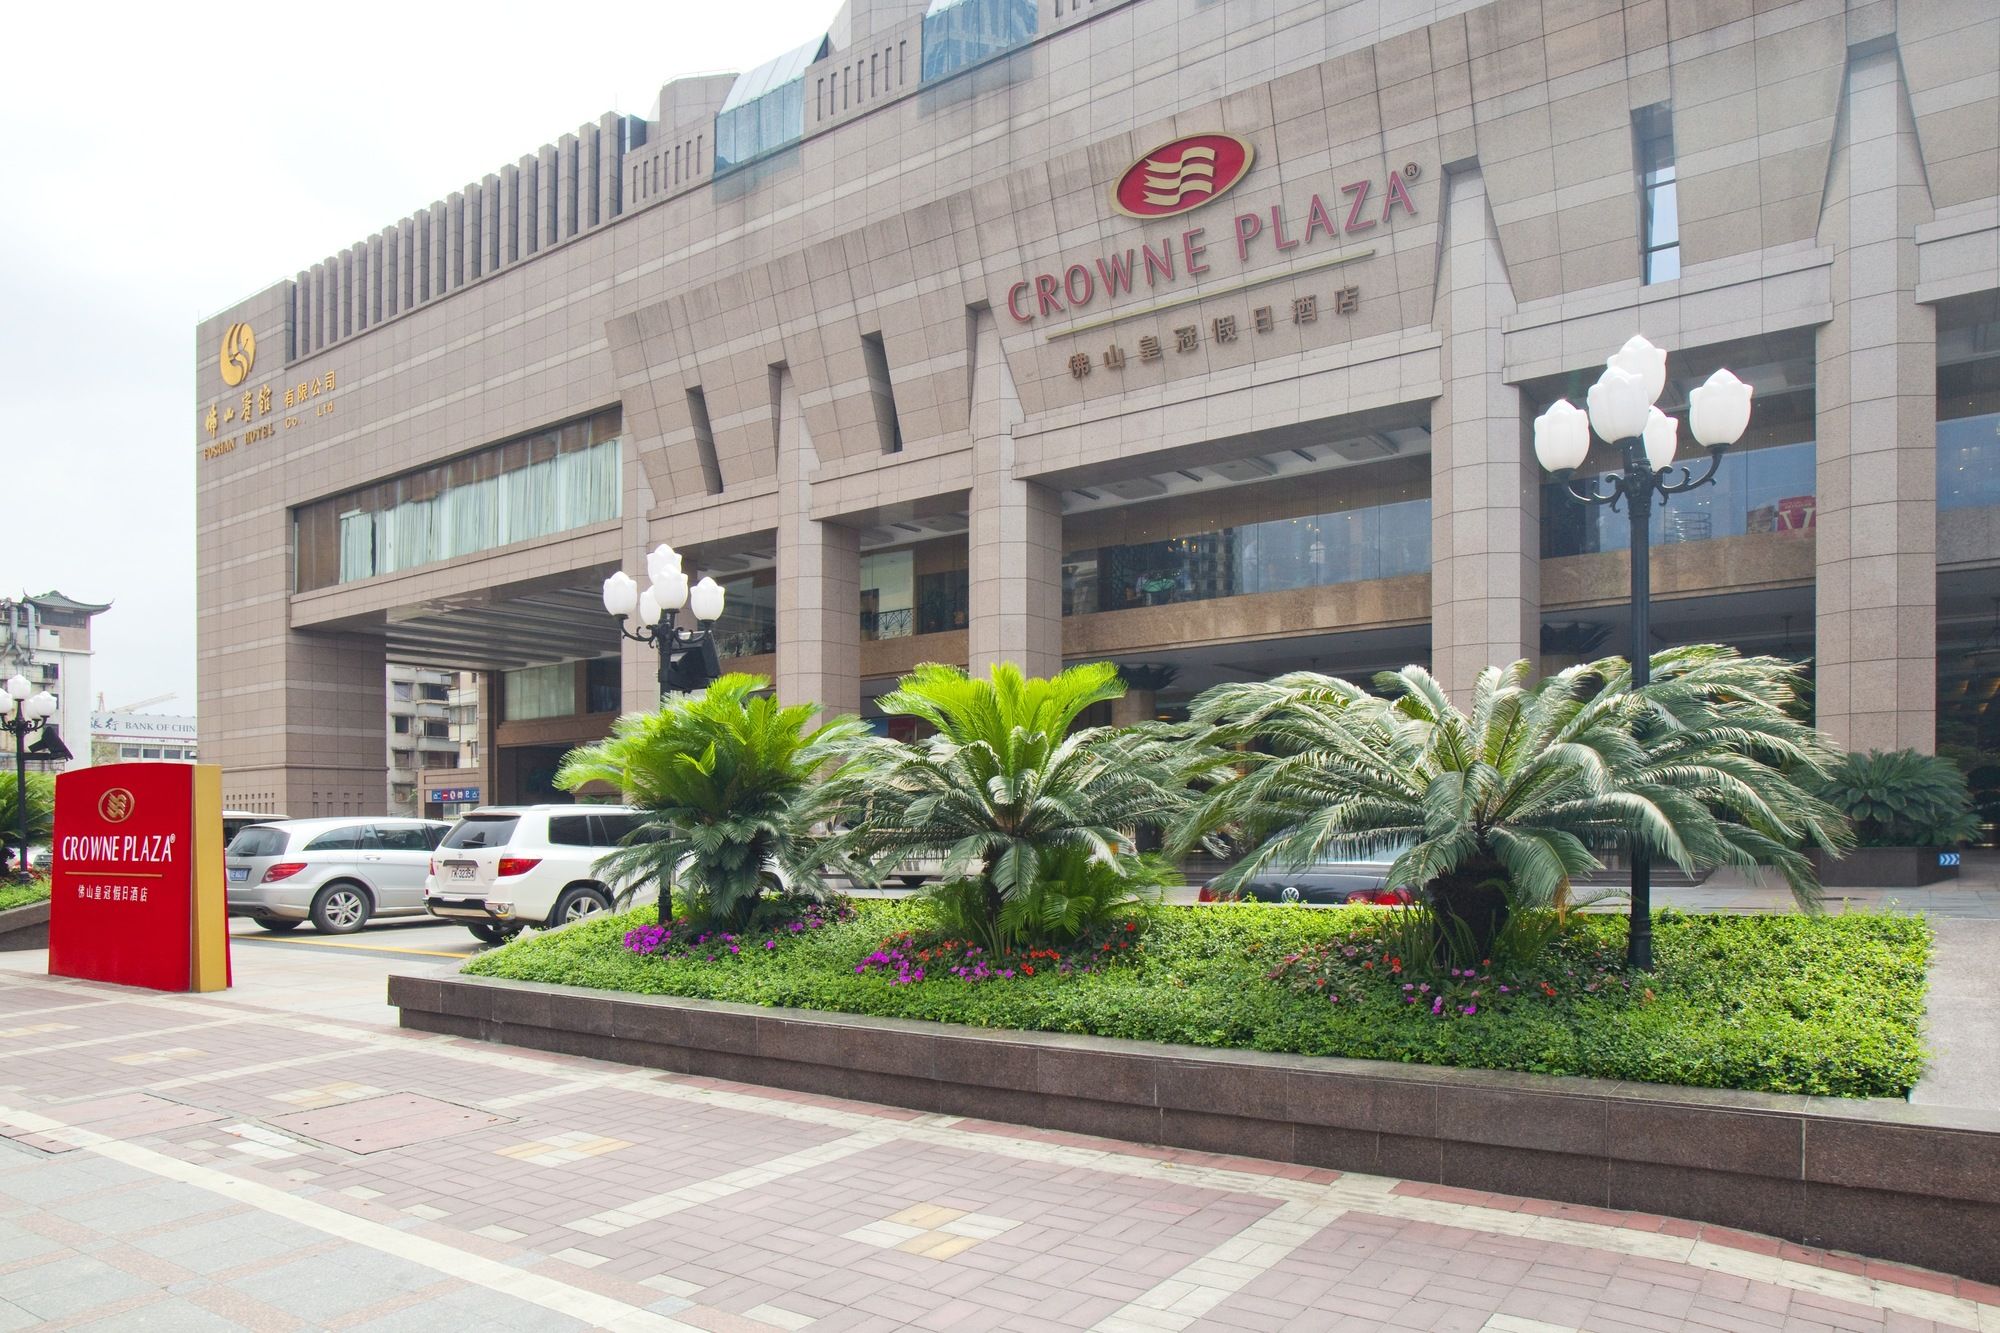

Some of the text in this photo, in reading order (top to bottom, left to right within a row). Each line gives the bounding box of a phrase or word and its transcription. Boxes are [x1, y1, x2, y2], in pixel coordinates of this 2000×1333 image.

[1007, 227, 1209, 324] CROWNE
[245, 423, 275, 445] HOTEL
[125, 721, 154, 732] BANK
[156, 723, 170, 733] OF
[62, 834, 121, 861] CROWNE
[77, 884, 149, 903] 佛山皇冠假日酒店
